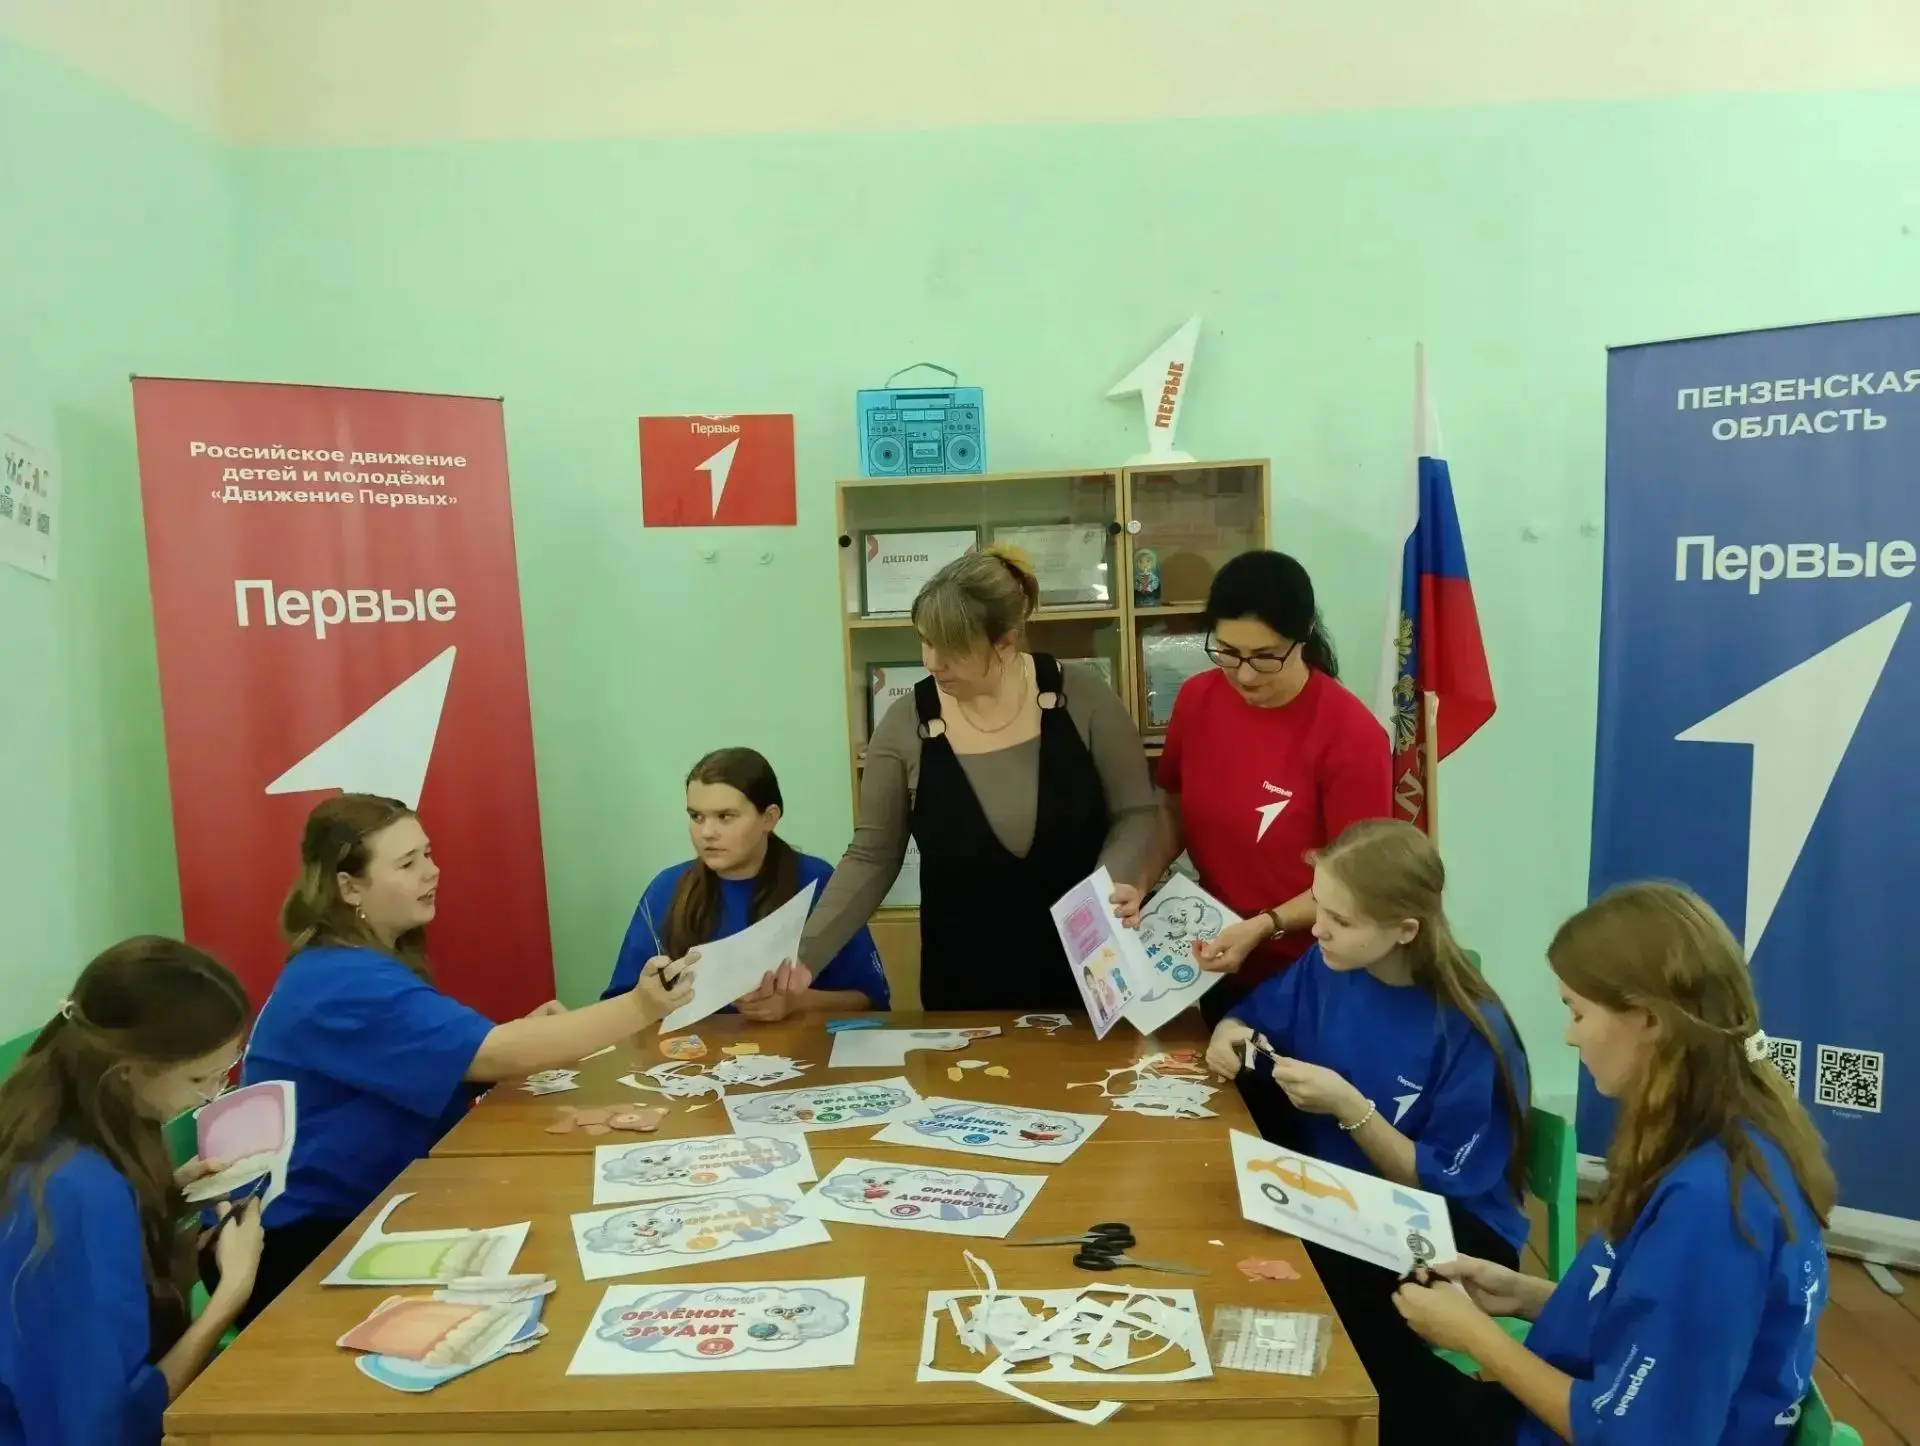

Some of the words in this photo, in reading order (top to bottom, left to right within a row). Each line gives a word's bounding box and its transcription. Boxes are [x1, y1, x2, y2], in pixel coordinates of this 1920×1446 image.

[1155, 361, 1184, 428] ПЕРВЫЕ
[1677, 368, 1920, 410] ПЕНЗЕНСКАЯ
[691, 422, 740, 438] Первые
[1712, 408, 1887, 441] ОБЛАСТЬ
[190, 441, 345, 462] Российское
[350, 451, 467, 467] движение
[222, 465, 297, 481] детей
[303, 470, 318, 481] и
[324, 469, 445, 486] молодёжи
[211, 485, 354, 503] «Движение
[359, 489, 458, 507] Первых»
[1675, 535, 1917, 595] Первые
[234, 579, 457, 640] Первые
[1262, 780, 1293, 798] Первые
[894, 1193, 1009, 1211] ДОБРОВОЛЕЦ
[622, 1324, 739, 1338] ЭРУДИТ
[1614, 1356, 1656, 1416] Первые
